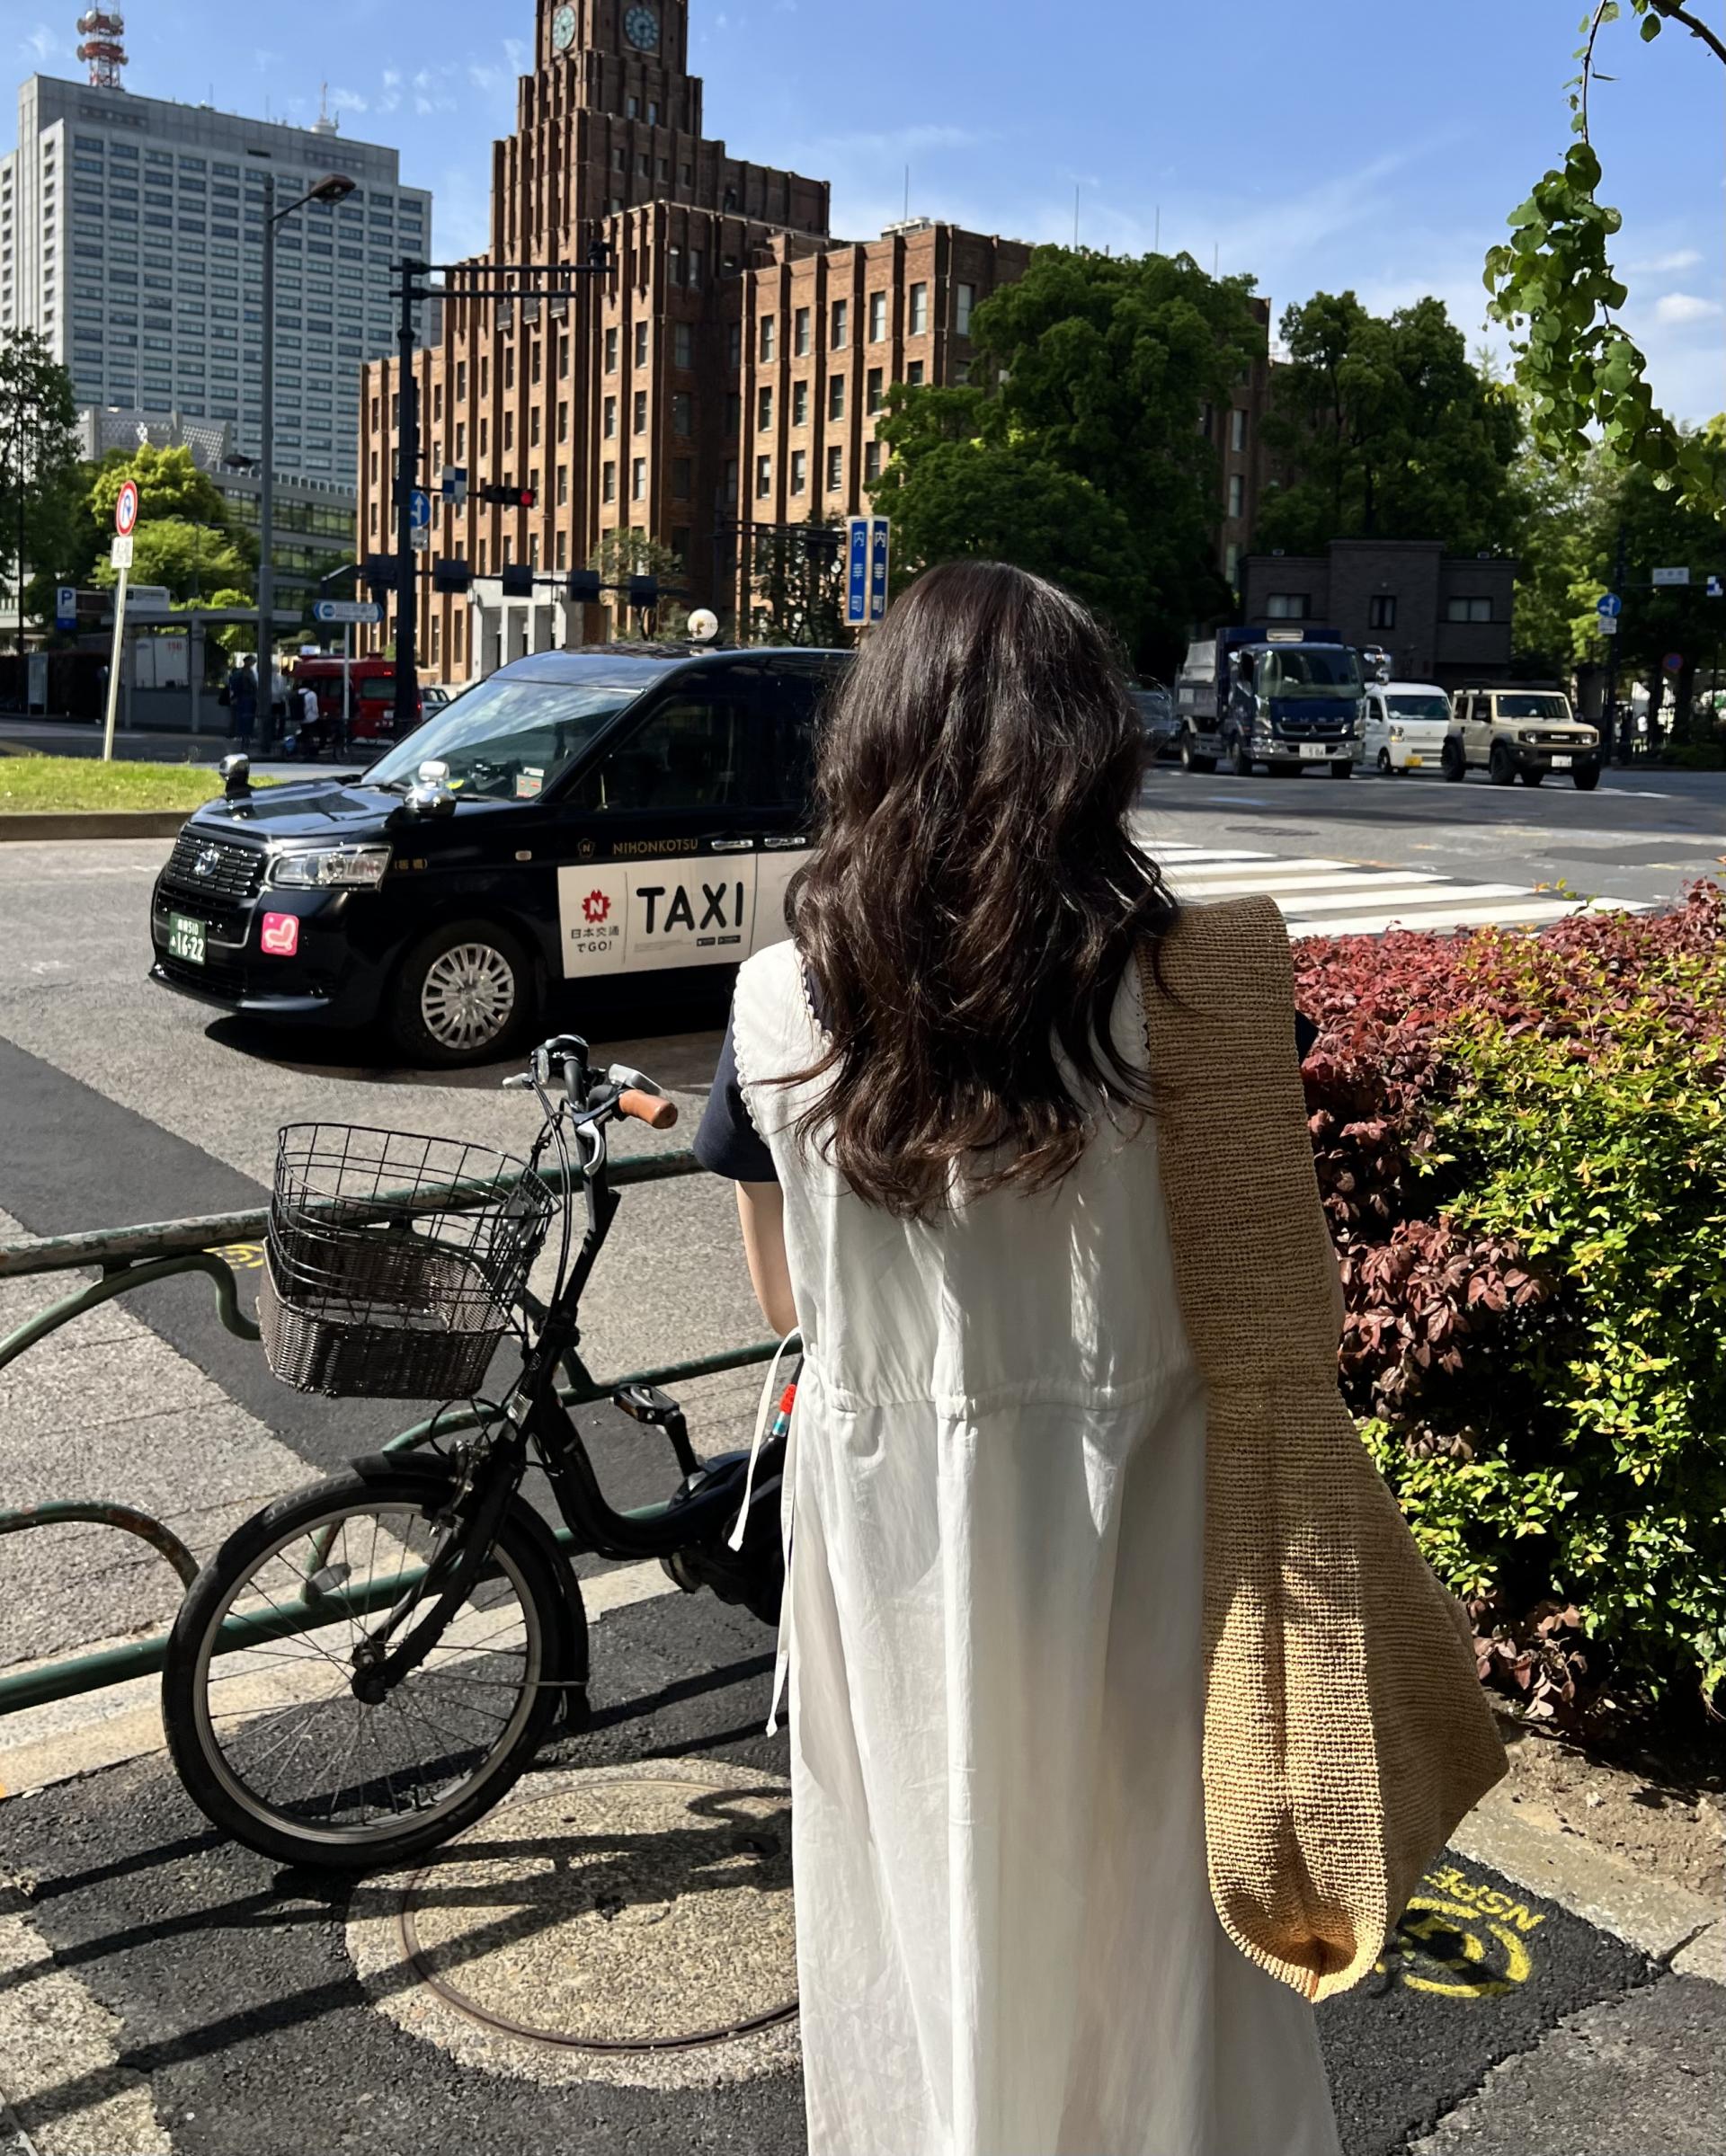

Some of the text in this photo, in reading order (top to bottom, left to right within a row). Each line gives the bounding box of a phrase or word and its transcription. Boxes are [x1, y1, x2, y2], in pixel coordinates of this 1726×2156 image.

[613, 838, 698, 854] NIHONKOTSU
[636, 882, 743, 934] TAXI
[571, 926, 619, 939] 日本交通
[577, 941, 612, 953] でGO!
